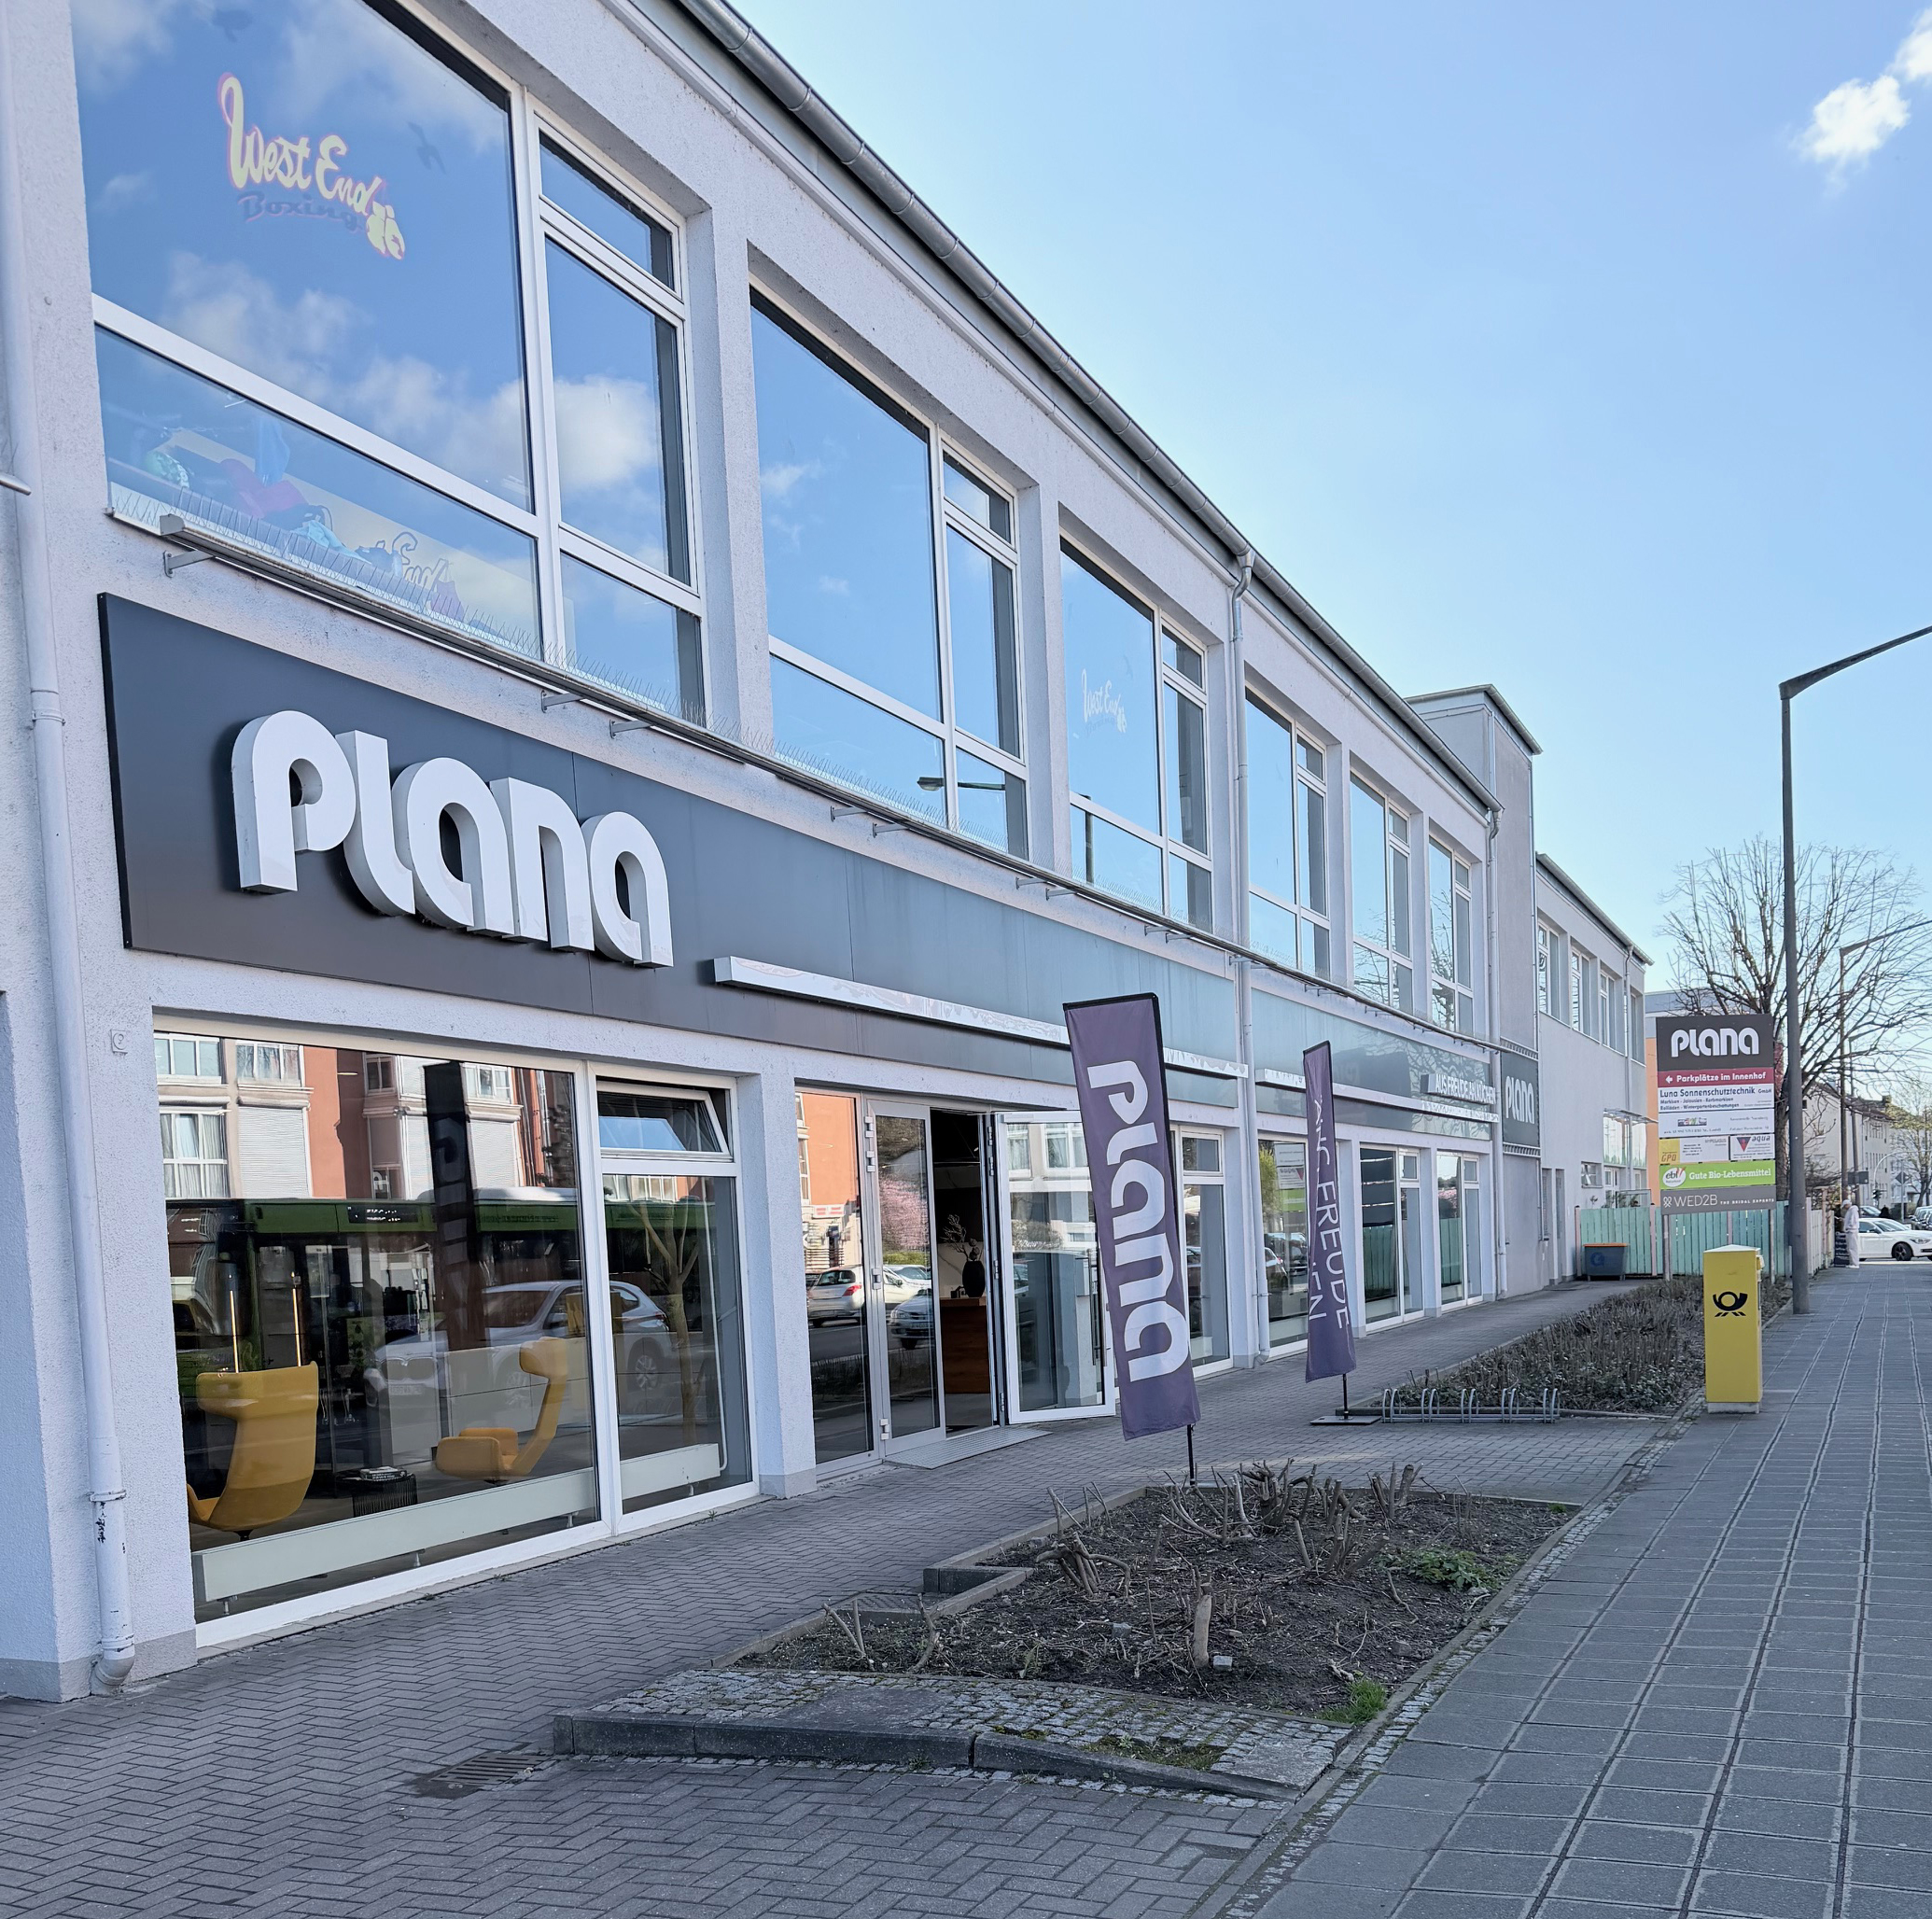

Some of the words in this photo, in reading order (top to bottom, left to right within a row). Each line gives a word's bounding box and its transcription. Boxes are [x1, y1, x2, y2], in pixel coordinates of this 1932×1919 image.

[218, 73, 312, 189] West
[315, 133, 383, 217] End
[237, 191, 363, 232] Boxing
[1676, 1073, 1719, 1084] Parkplätze
[1721, 1072, 1730, 1081] im
[1732, 1072, 1767, 1081] Innenhof
[1659, 1089, 1678, 1098] Luna
[1680, 1086, 1756, 1097] Sonnenschutztechnik
[1751, 1135, 1771, 1143] aqua
[1688, 1171, 1707, 1180] Gute
[1708, 1169, 1771, 1179] Bio-Lebensmittel
[1673, 1195, 1718, 1207] WED2B
